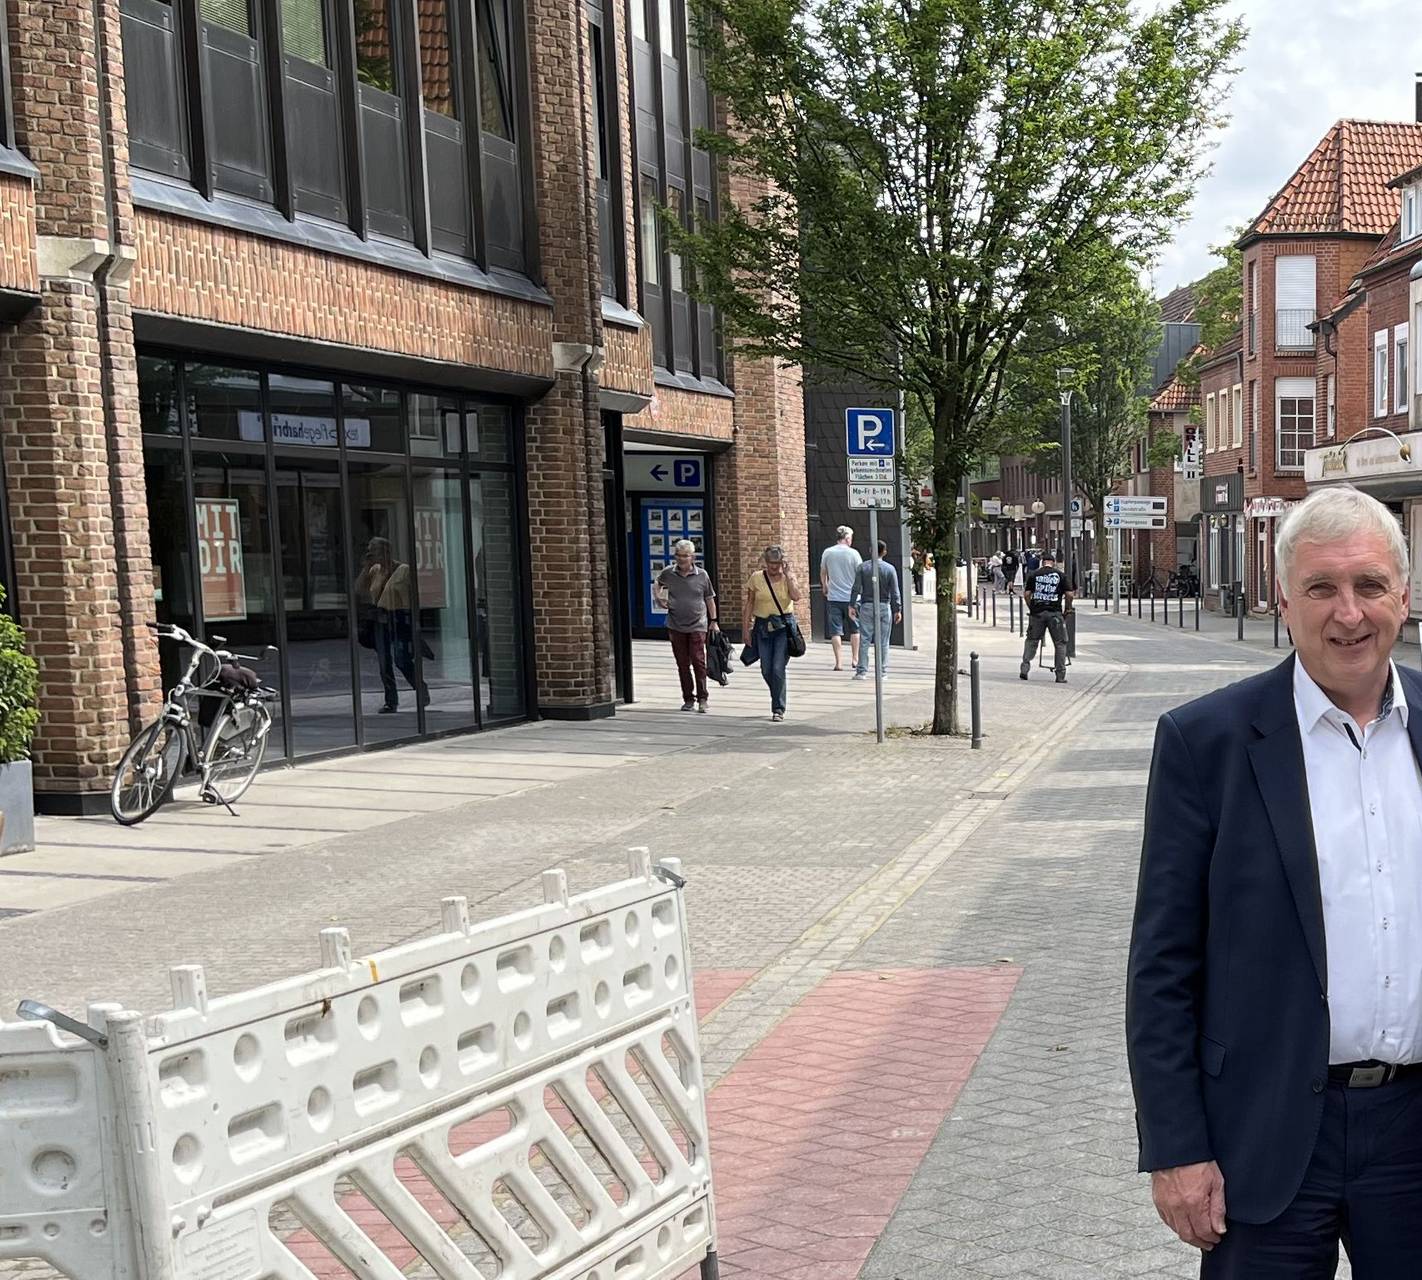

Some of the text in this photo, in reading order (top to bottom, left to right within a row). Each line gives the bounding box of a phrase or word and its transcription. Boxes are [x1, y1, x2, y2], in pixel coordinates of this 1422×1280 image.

[857, 414, 883, 450] P
[680, 463, 696, 483] P
[195, 503, 238, 539] MIT
[199, 540, 242, 574] DIR
